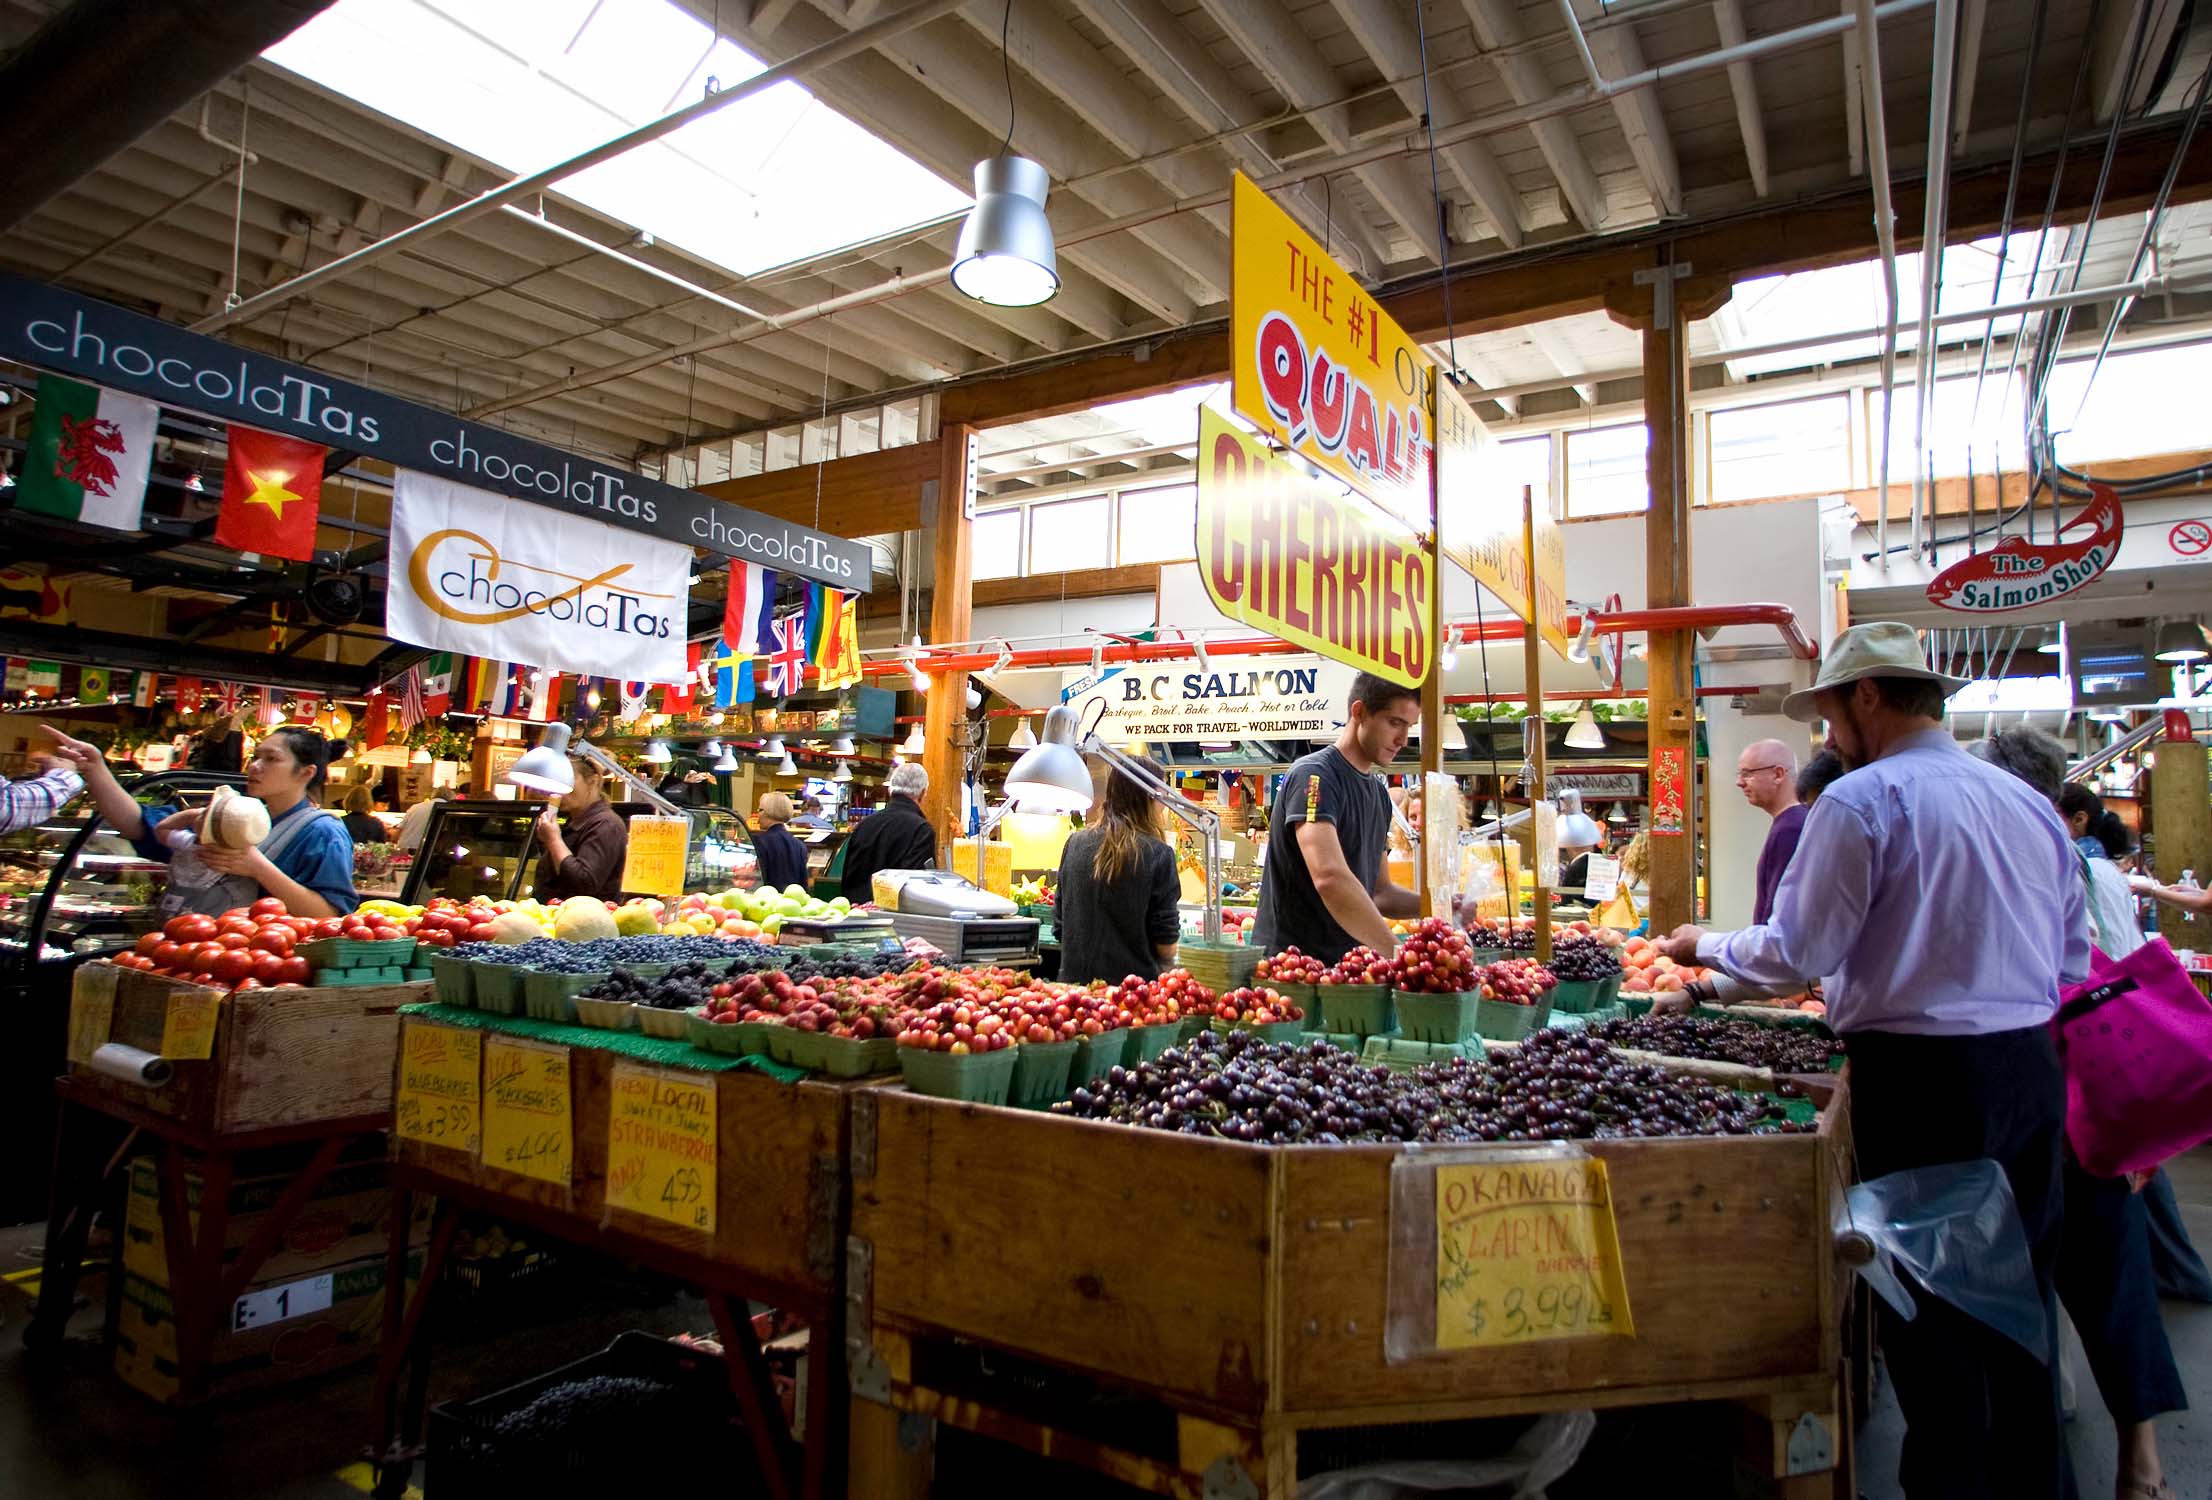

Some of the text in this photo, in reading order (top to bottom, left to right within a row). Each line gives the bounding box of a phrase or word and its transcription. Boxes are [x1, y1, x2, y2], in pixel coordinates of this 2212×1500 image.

[1286, 239, 1334, 326] THE
[1347, 295, 1381, 368] #1
[26, 309, 381, 443] chocolaTas
[430, 429, 658, 524] chocolaTas
[691, 507, 852, 578] chocolaTas
[1212, 432, 1426, 680] CHERRIES
[1990, 553, 2046, 574] The
[439, 557, 671, 641] chocolaTas
[1961, 546, 2106, 609] Salmon Shop
[1067, 675, 1099, 698] FRESH
[1182, 668, 1318, 700] SALMON
[1259, 700, 1281, 712] Hot
[1284, 703, 1296, 712] or
[1299, 698, 1329, 712] Cold
[1124, 725, 1142, 735] WE
[1143, 724, 1170, 734] PACK
[1172, 723, 1194, 734] FOR
[651, 1078, 710, 1115] LOCAL
[1445, 1167, 1607, 1215] OKANAGA
[1467, 1214, 1569, 1259] LAPIN
